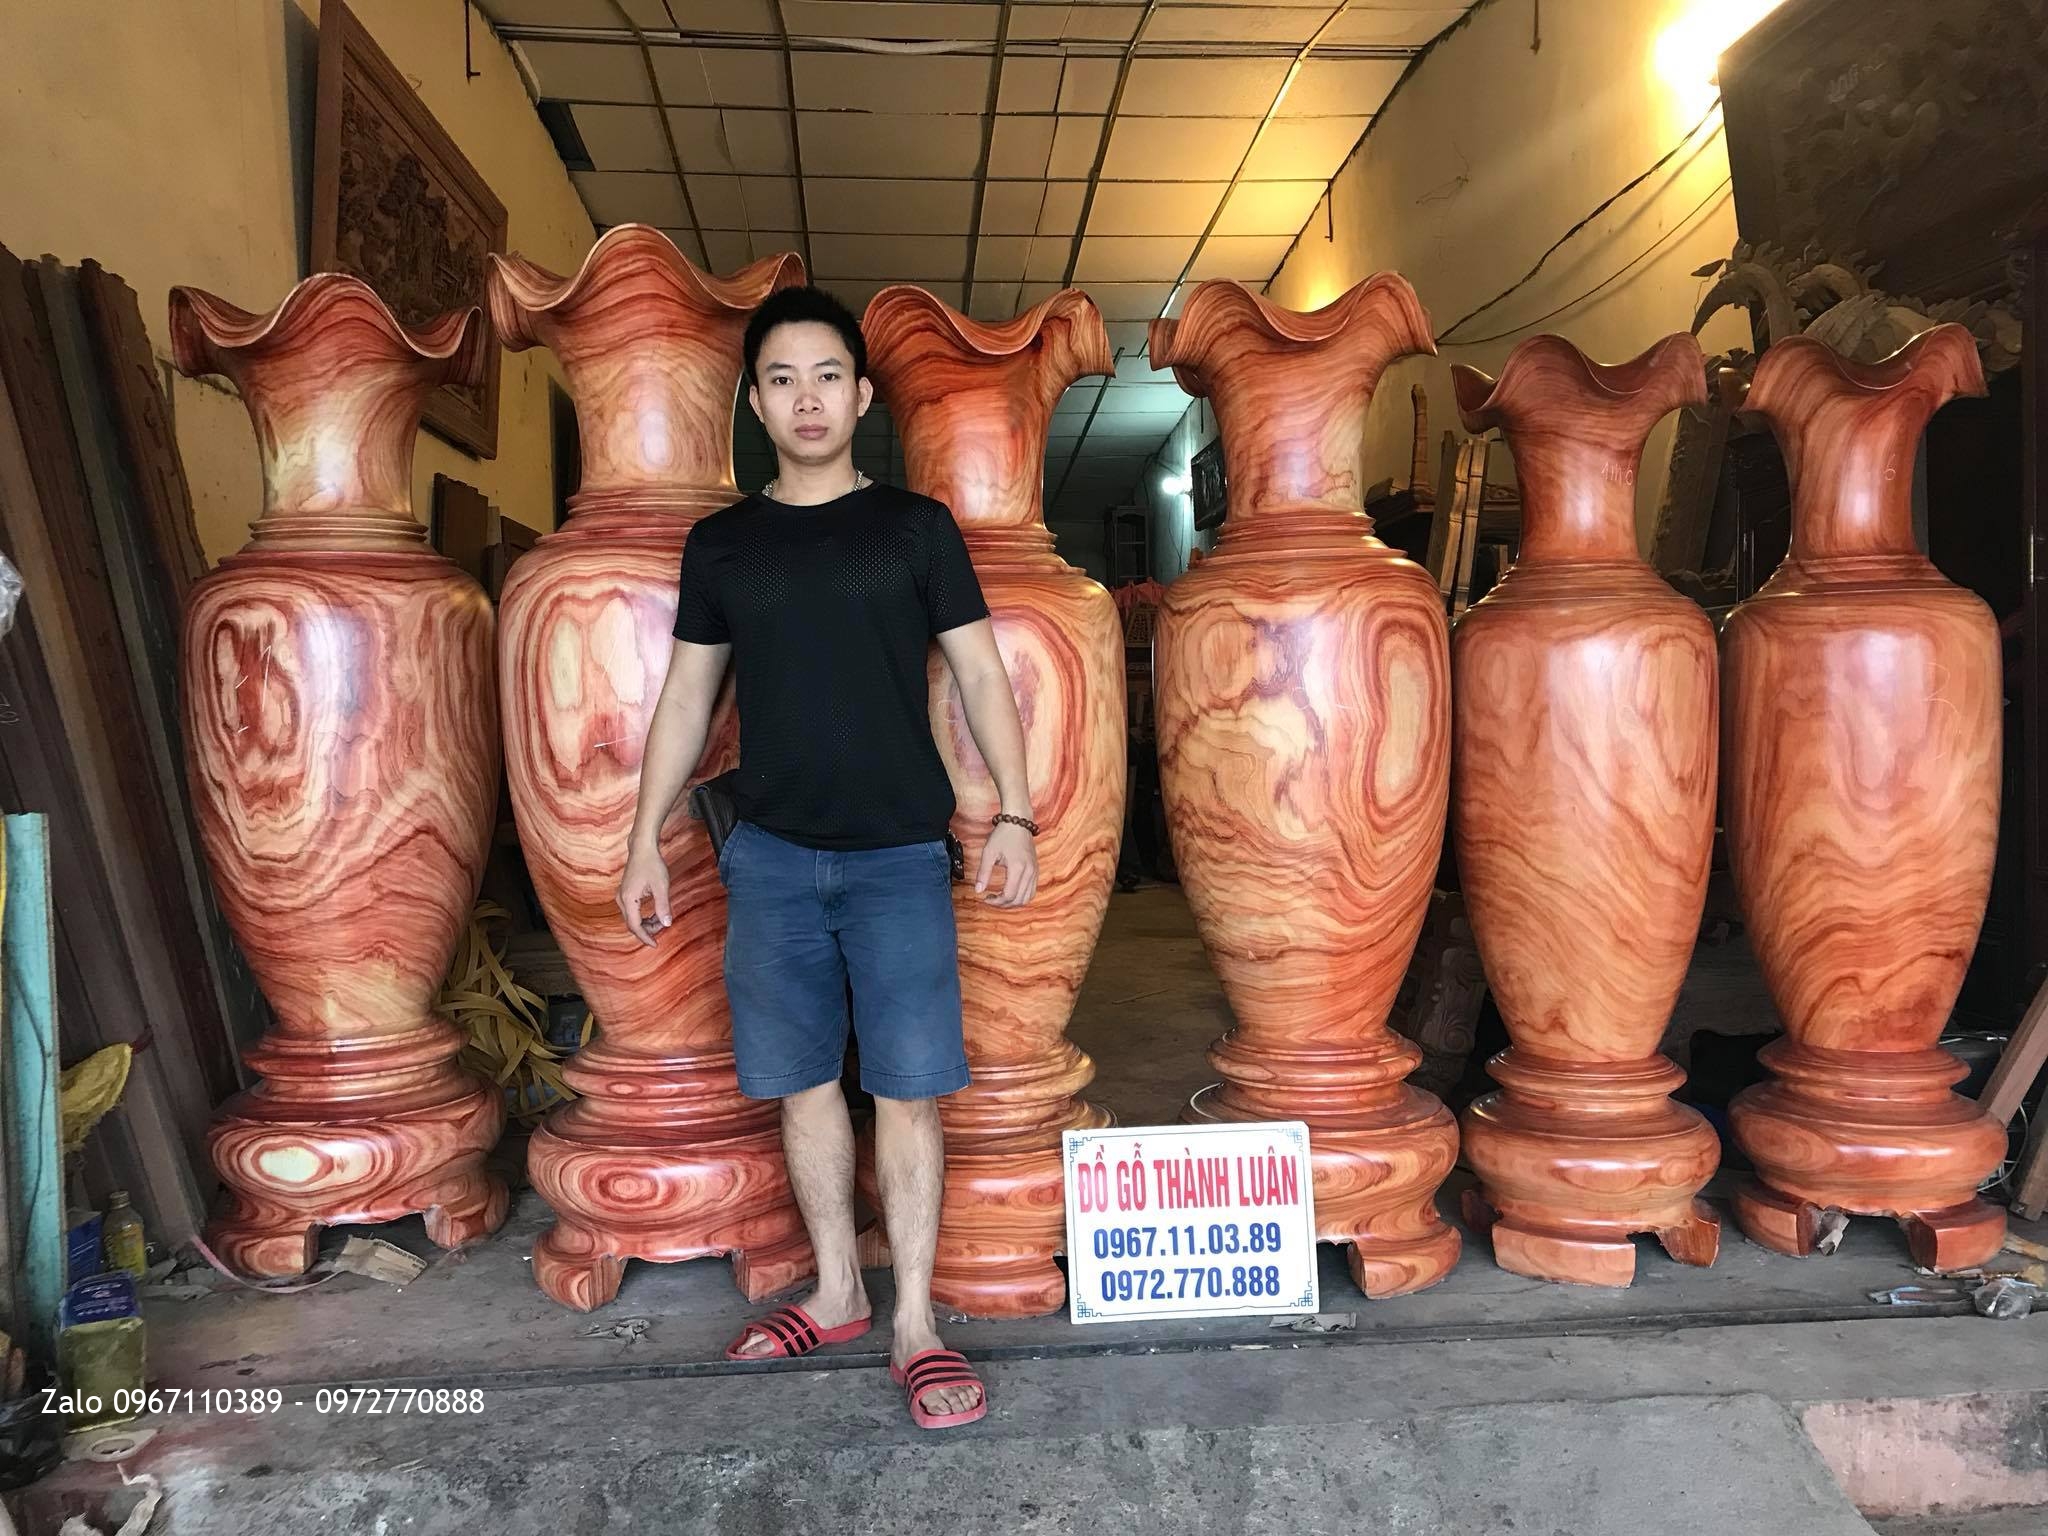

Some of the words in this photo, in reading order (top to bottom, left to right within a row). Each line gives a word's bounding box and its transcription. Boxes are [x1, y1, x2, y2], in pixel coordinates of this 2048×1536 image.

[1077, 1144, 1108, 1212] ĐỒ
[1116, 1142, 1146, 1211] GỖ
[1153, 1147, 1230, 1209] THÀNH
[1237, 1145, 1298, 1206] LUÂN
[1093, 1222, 1281, 1259] 0967.11.03.89
[1101, 1265, 1280, 1301] 0972.770.888
